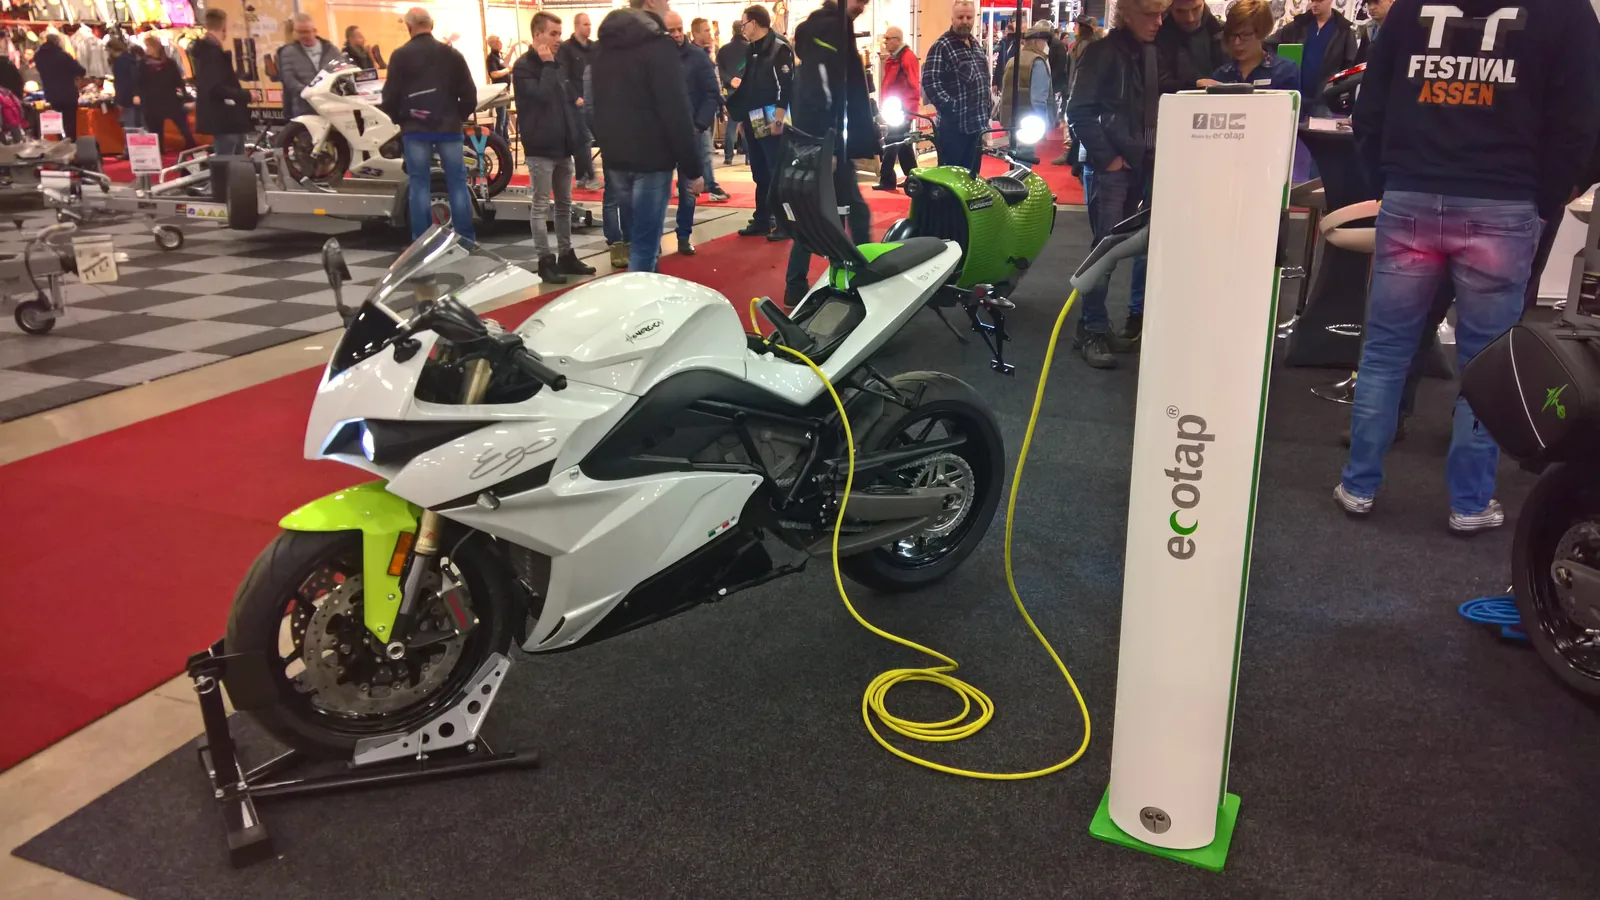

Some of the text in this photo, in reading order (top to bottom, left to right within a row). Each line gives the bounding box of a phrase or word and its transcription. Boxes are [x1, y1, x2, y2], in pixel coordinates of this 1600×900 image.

[1420, 5, 1519, 51] TT
[1408, 55, 1516, 83] FESTIVAL
[1418, 80, 1494, 105] ASSEN
[1212, 132, 1245, 140] ecotap
[360, 166, 385, 176] 23
[469, 437, 557, 480] Ego
